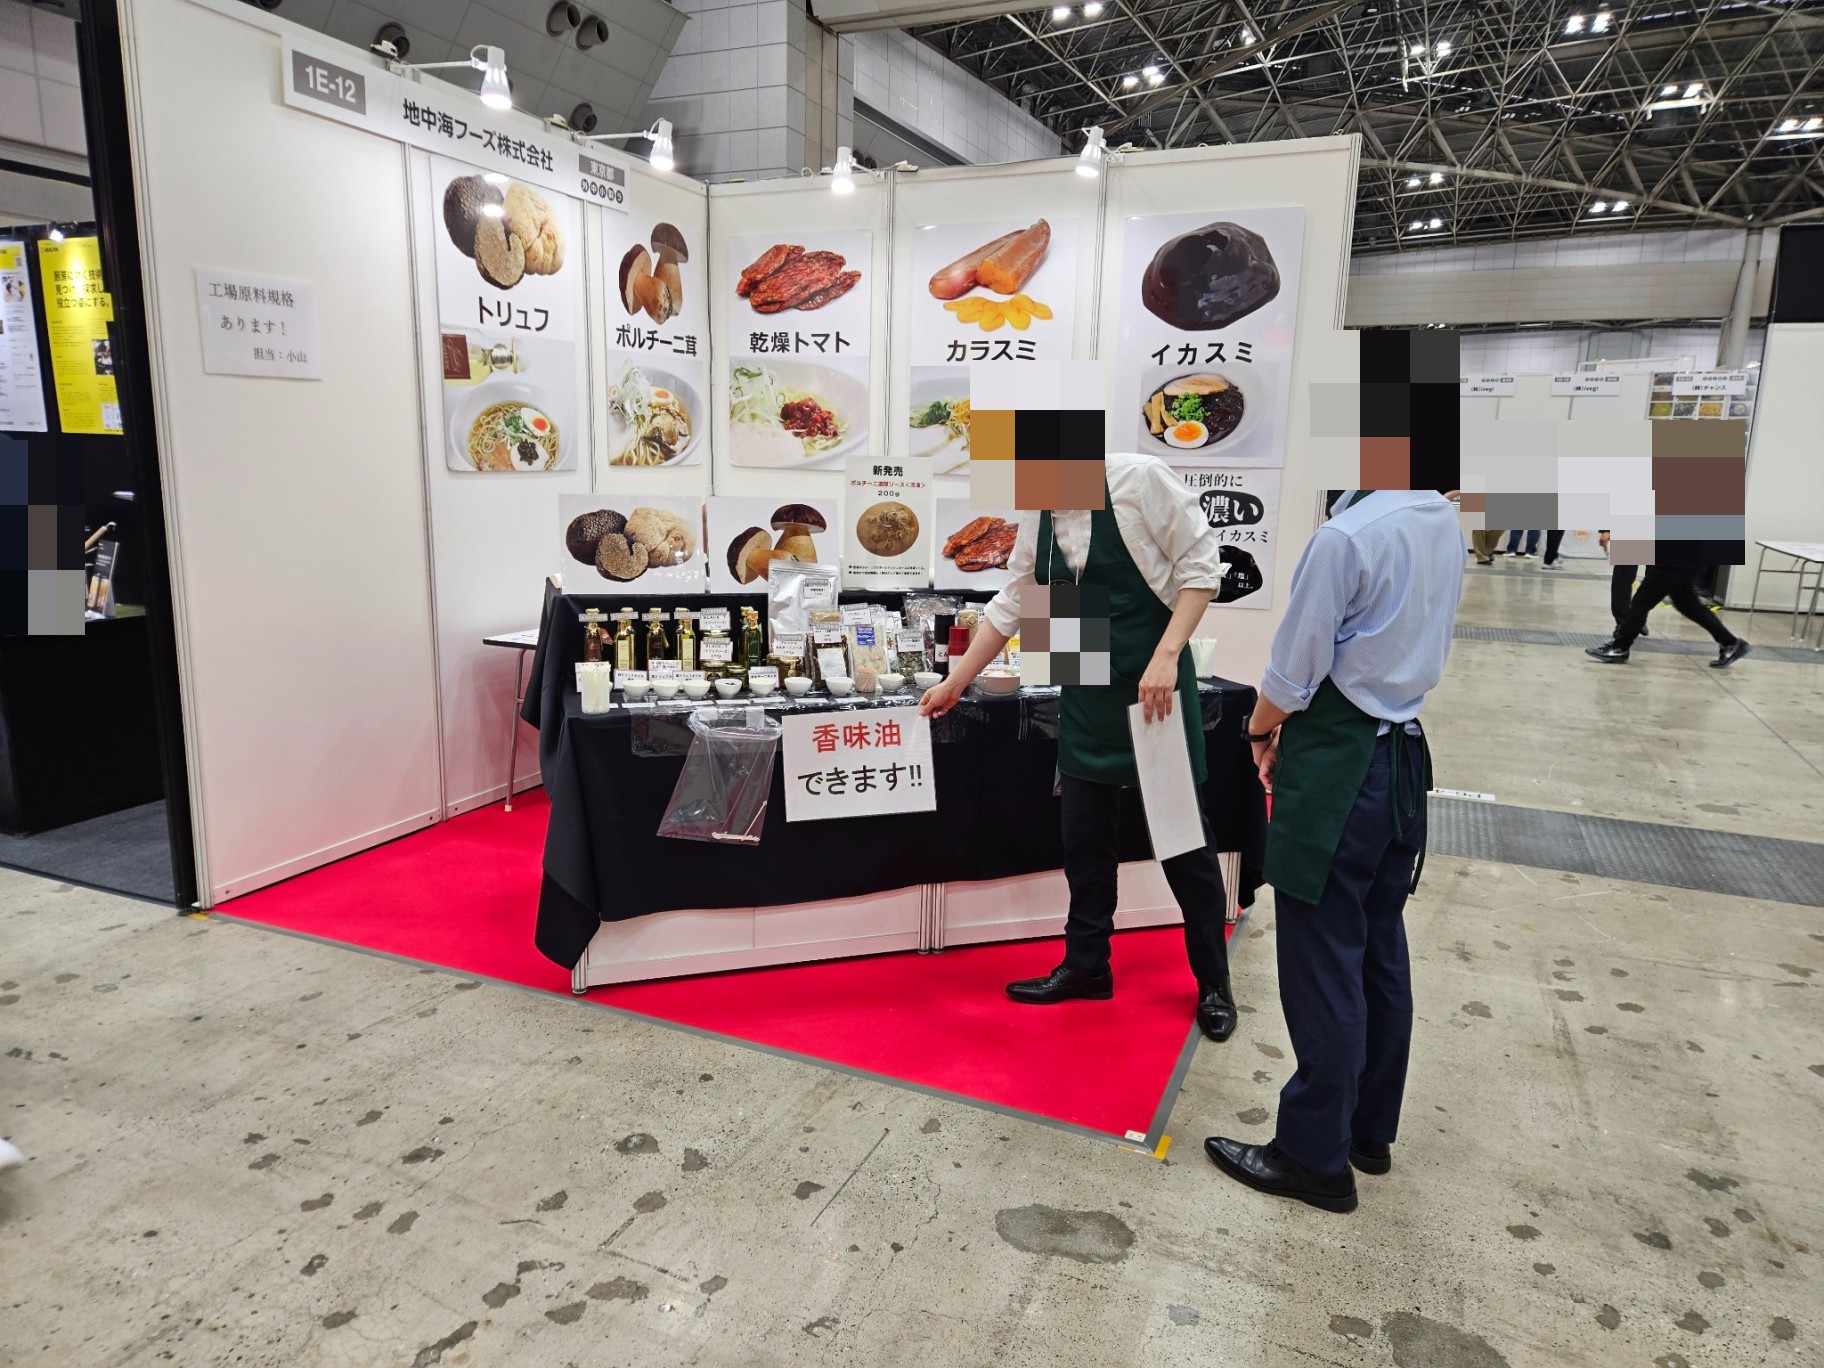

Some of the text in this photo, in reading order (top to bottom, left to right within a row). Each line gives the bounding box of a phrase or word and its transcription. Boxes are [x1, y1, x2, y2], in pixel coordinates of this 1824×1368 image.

[304, 64, 357, 104] 1E-12
[402, 97, 554, 173] 地中海フーズ株式会社
[208, 281, 294, 308] 工場原料規格
[220, 314, 287, 336] あります！
[478, 295, 550, 332] トリュフ
[615, 323, 699, 358] ポルチーニ茸
[749, 330, 851, 354] 乾燥トマト
[946, 338, 1037, 361] カラスミ
[1150, 339, 1254, 366] イカスミ
[253, 346, 307, 363] 担当：小山
[873, 465, 904, 477] 新発売
[1184, 473, 1244, 488] 圧倒的に
[878, 490, 900, 498] 200g
[1202, 495, 1260, 524] 濃い
[1217, 529, 1268, 543] イカスミ
[811, 718, 902, 753] 香味油
[797, 762, 923, 796] できます!!
